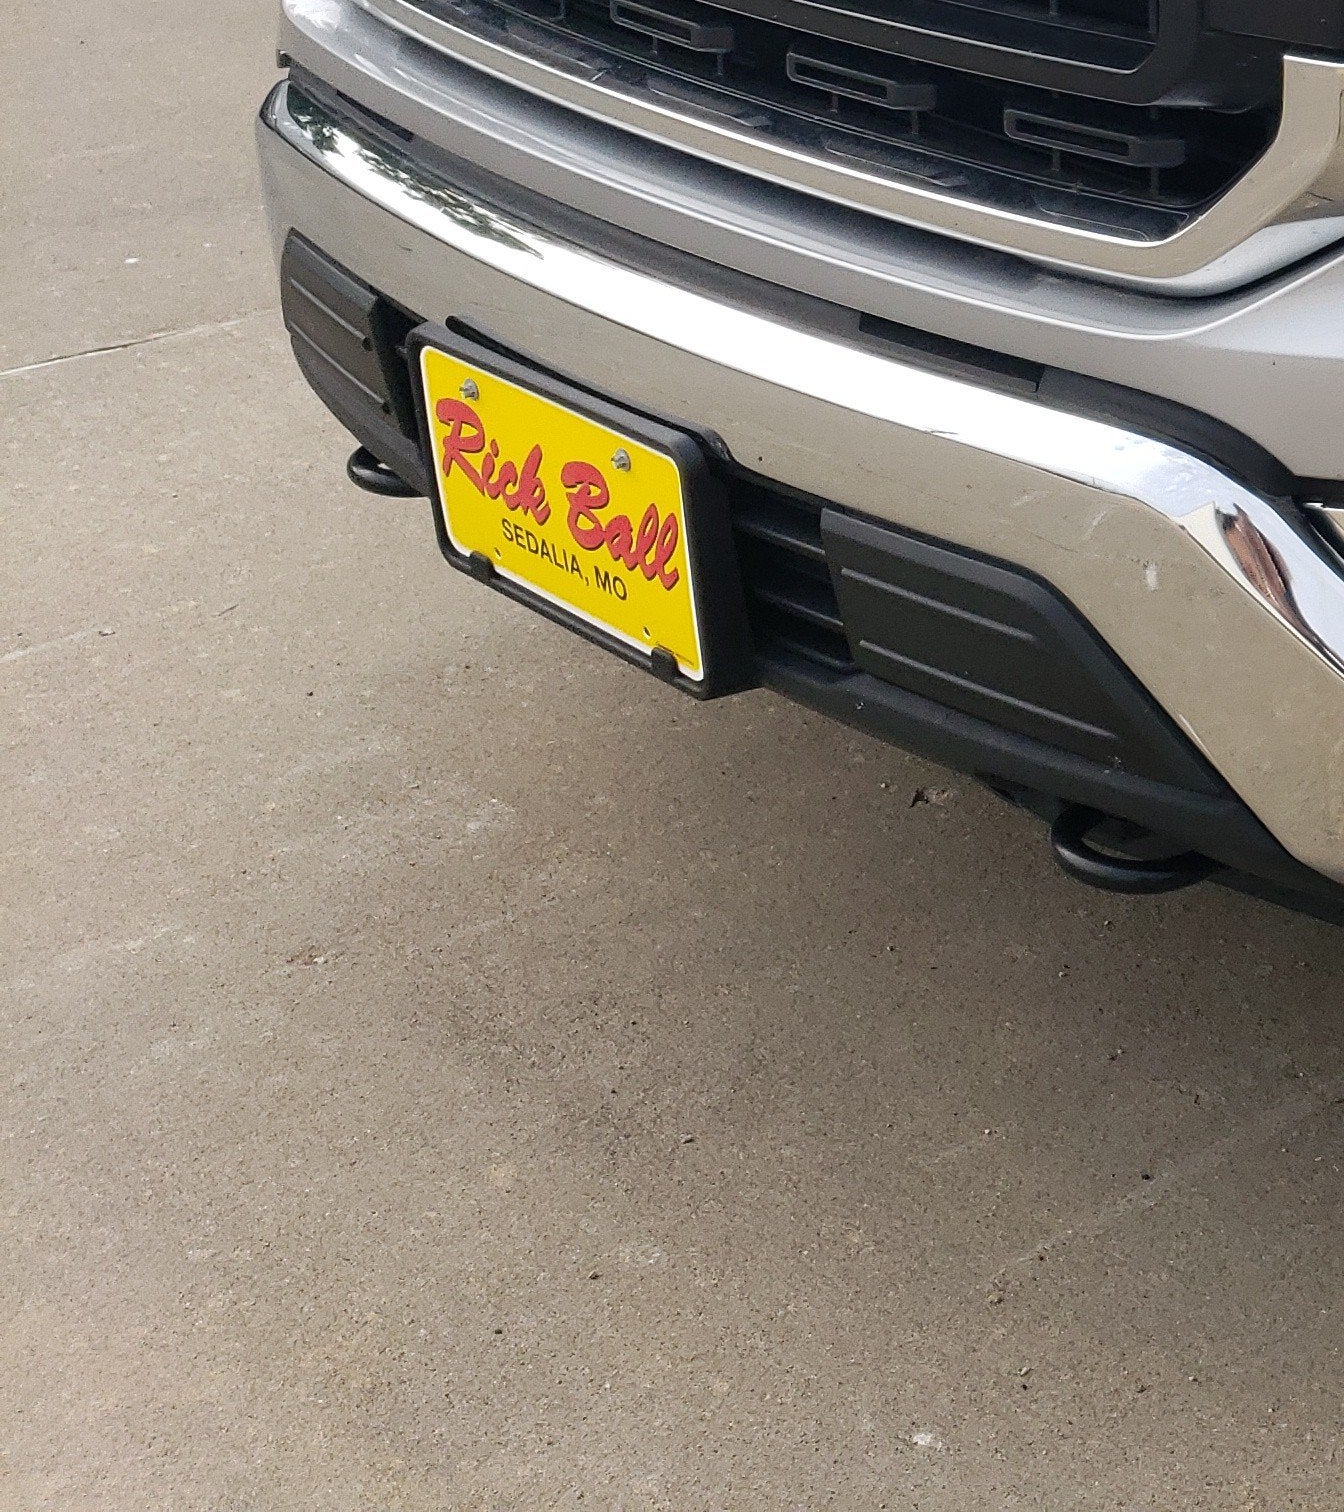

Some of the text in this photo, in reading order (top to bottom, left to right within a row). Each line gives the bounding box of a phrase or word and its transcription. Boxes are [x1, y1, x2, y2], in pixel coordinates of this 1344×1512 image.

[435, 397, 680, 591] Rick Ball
[501, 517, 628, 601] SEDALIA, MO
